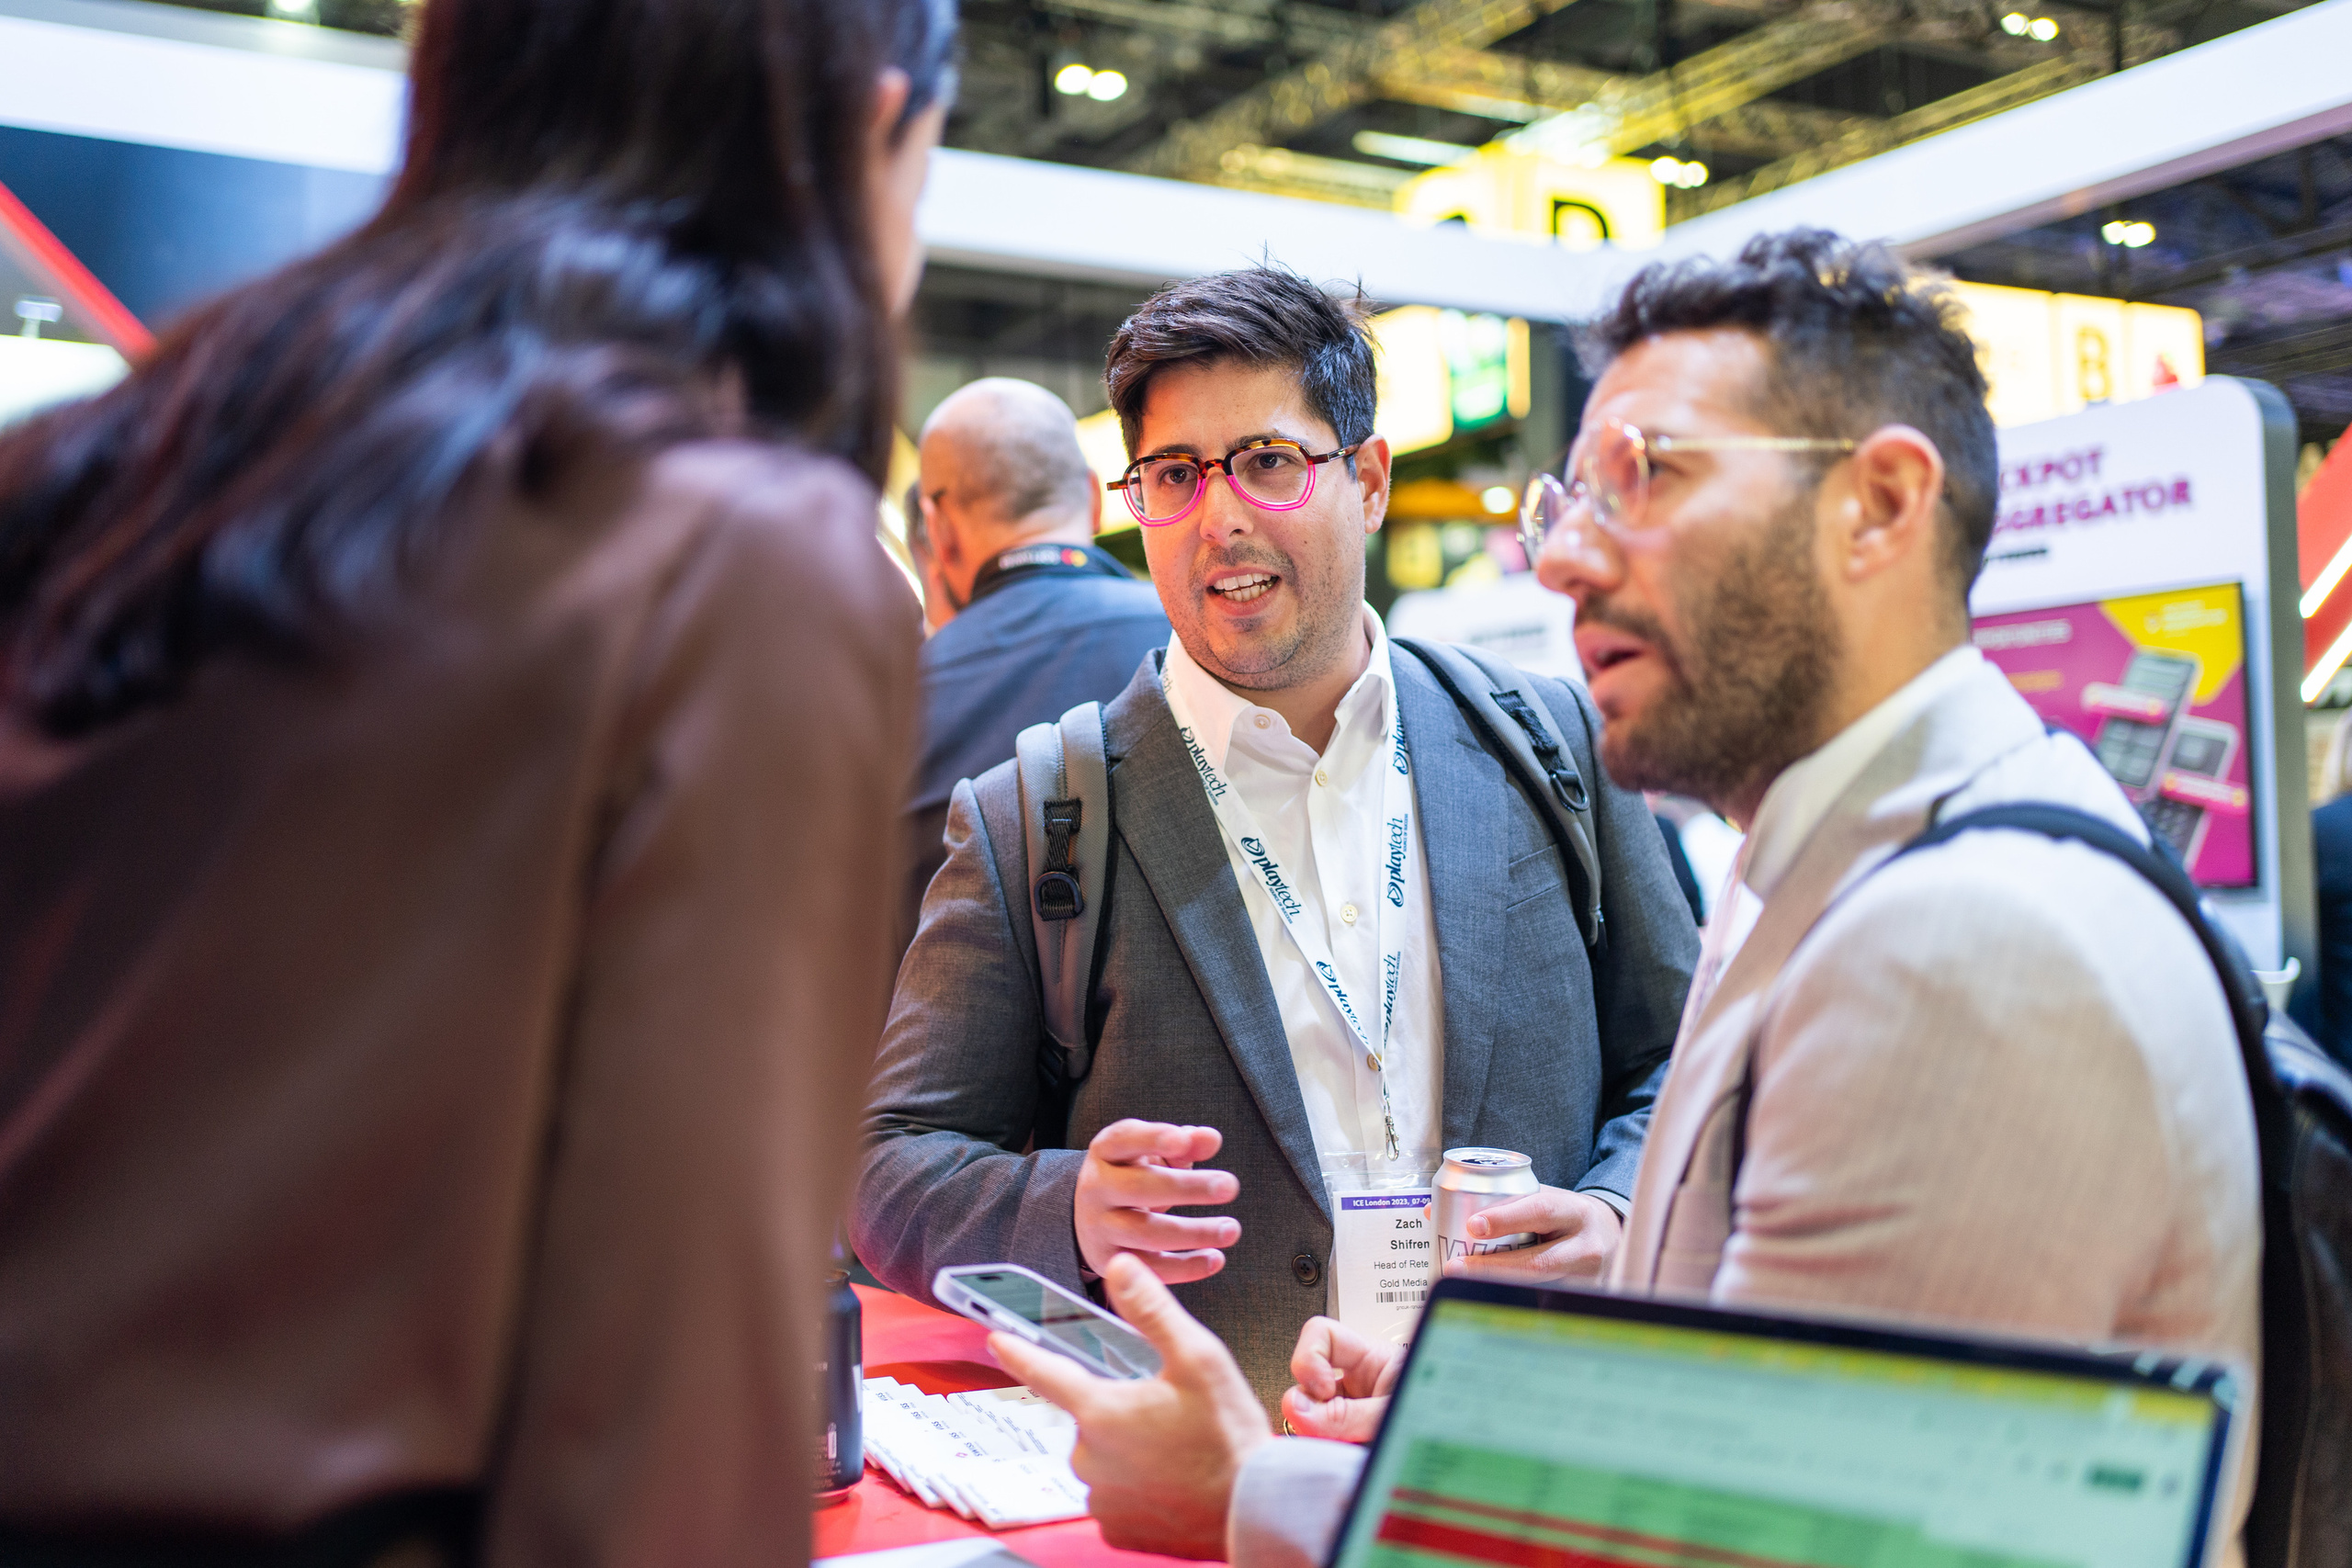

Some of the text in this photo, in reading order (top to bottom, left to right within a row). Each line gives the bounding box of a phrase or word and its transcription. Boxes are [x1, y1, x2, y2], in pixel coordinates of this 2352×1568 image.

[1188, 742, 1227, 798] playtech
[1385, 818, 1406, 885] playtech
[1251, 856, 1302, 918] playtech
[1383, 953, 1396, 1026] playtech
[1365, 1199, 1391, 1207] London
[1392, 1198, 1410, 1206] 2023,
[1396, 1218, 1422, 1229] Zach
[1390, 1238, 1430, 1250] Shifren
[1374, 1260, 1396, 1269] Head
[1398, 1259, 1407, 1269] of
[1380, 1278, 1428, 1289] Gold Media
